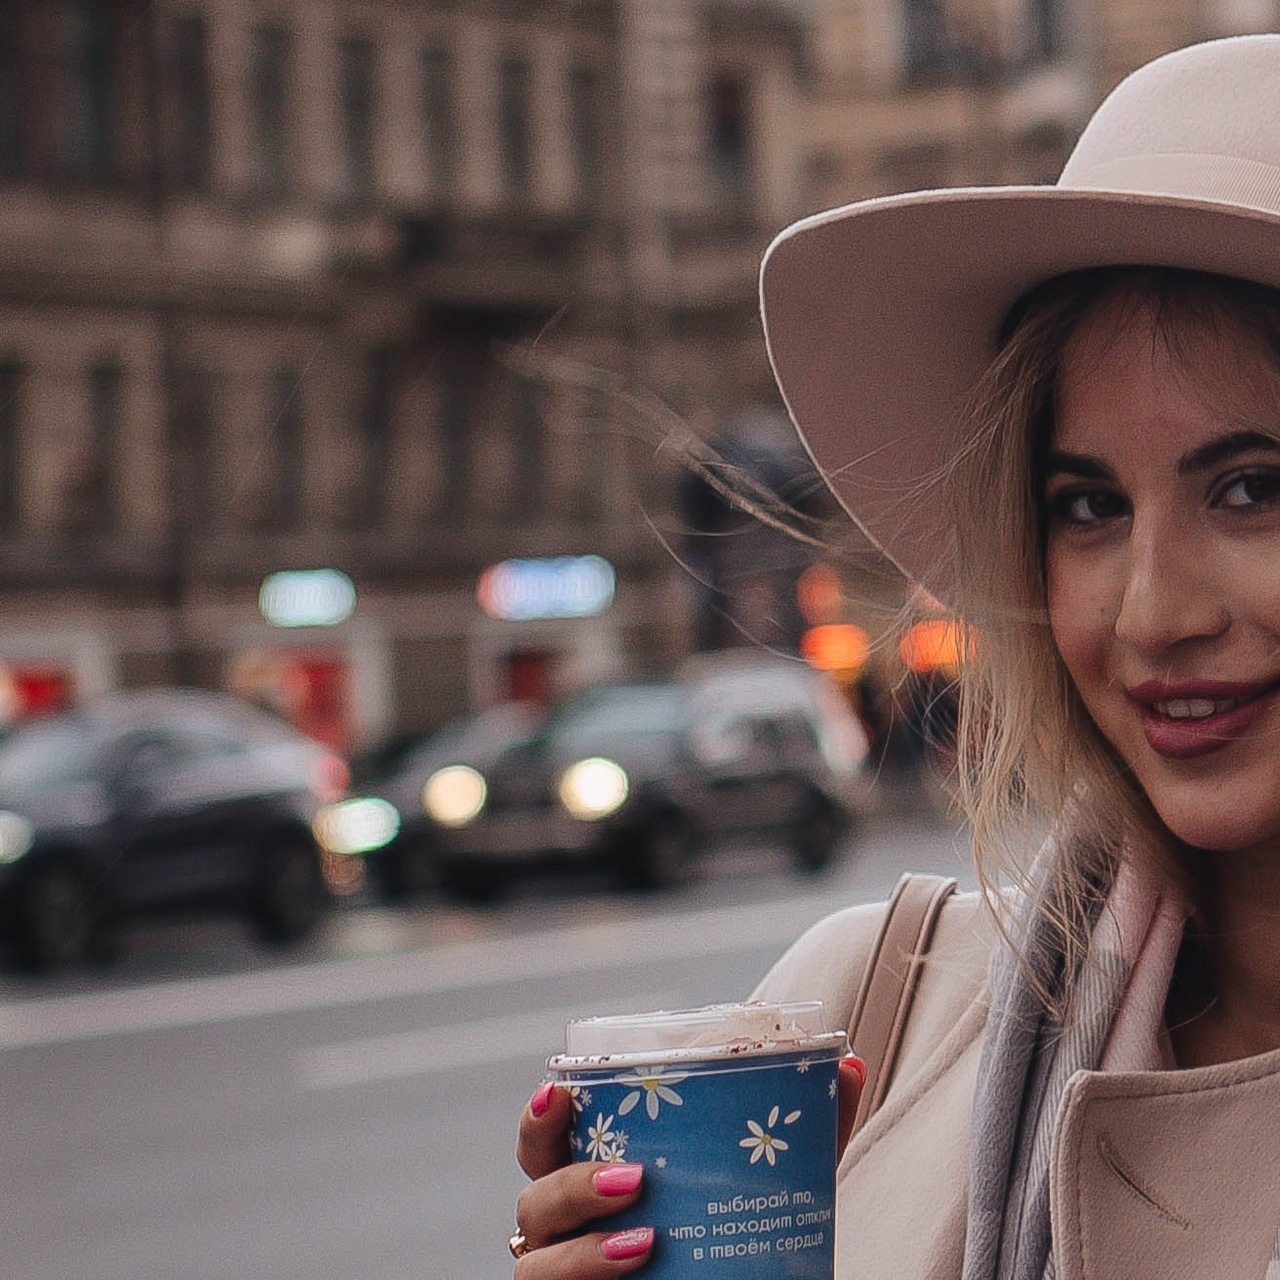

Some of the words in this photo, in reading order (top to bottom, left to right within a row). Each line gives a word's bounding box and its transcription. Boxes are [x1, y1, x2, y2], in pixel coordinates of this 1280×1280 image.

[707, 1190, 788, 1215] выбирай
[793, 1190, 815, 1205] то,
[669, 1225, 706, 1240] что
[713, 1215, 792, 1236] находит
[796, 1209, 833, 1226] откли
[693, 1247, 704, 1260] в
[710, 1237, 771, 1259] твоём
[776, 1231, 824, 1252] сердце
